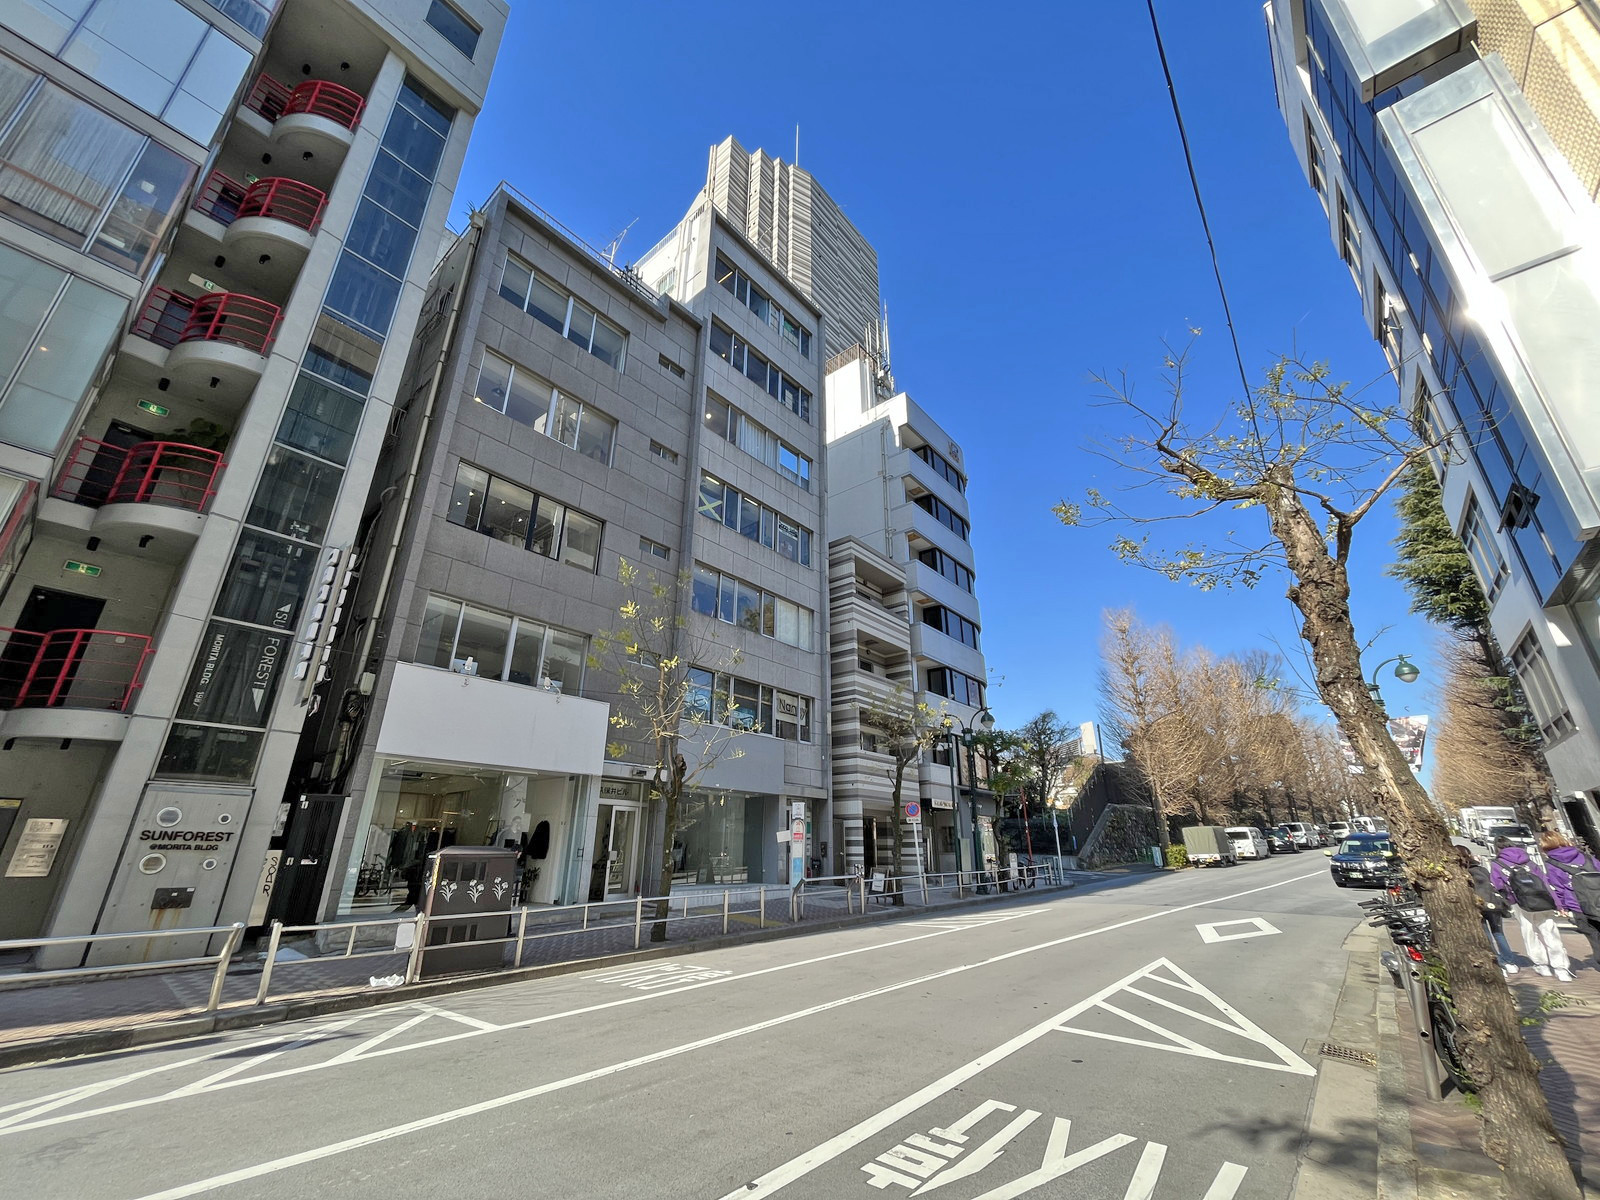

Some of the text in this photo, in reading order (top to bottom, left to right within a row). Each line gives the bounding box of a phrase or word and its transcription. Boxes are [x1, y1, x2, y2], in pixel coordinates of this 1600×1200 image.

[208, 634, 225, 662] MORITA
[254, 637, 281, 688] FOREST
[140, 830, 235, 842] SUNFOREST
